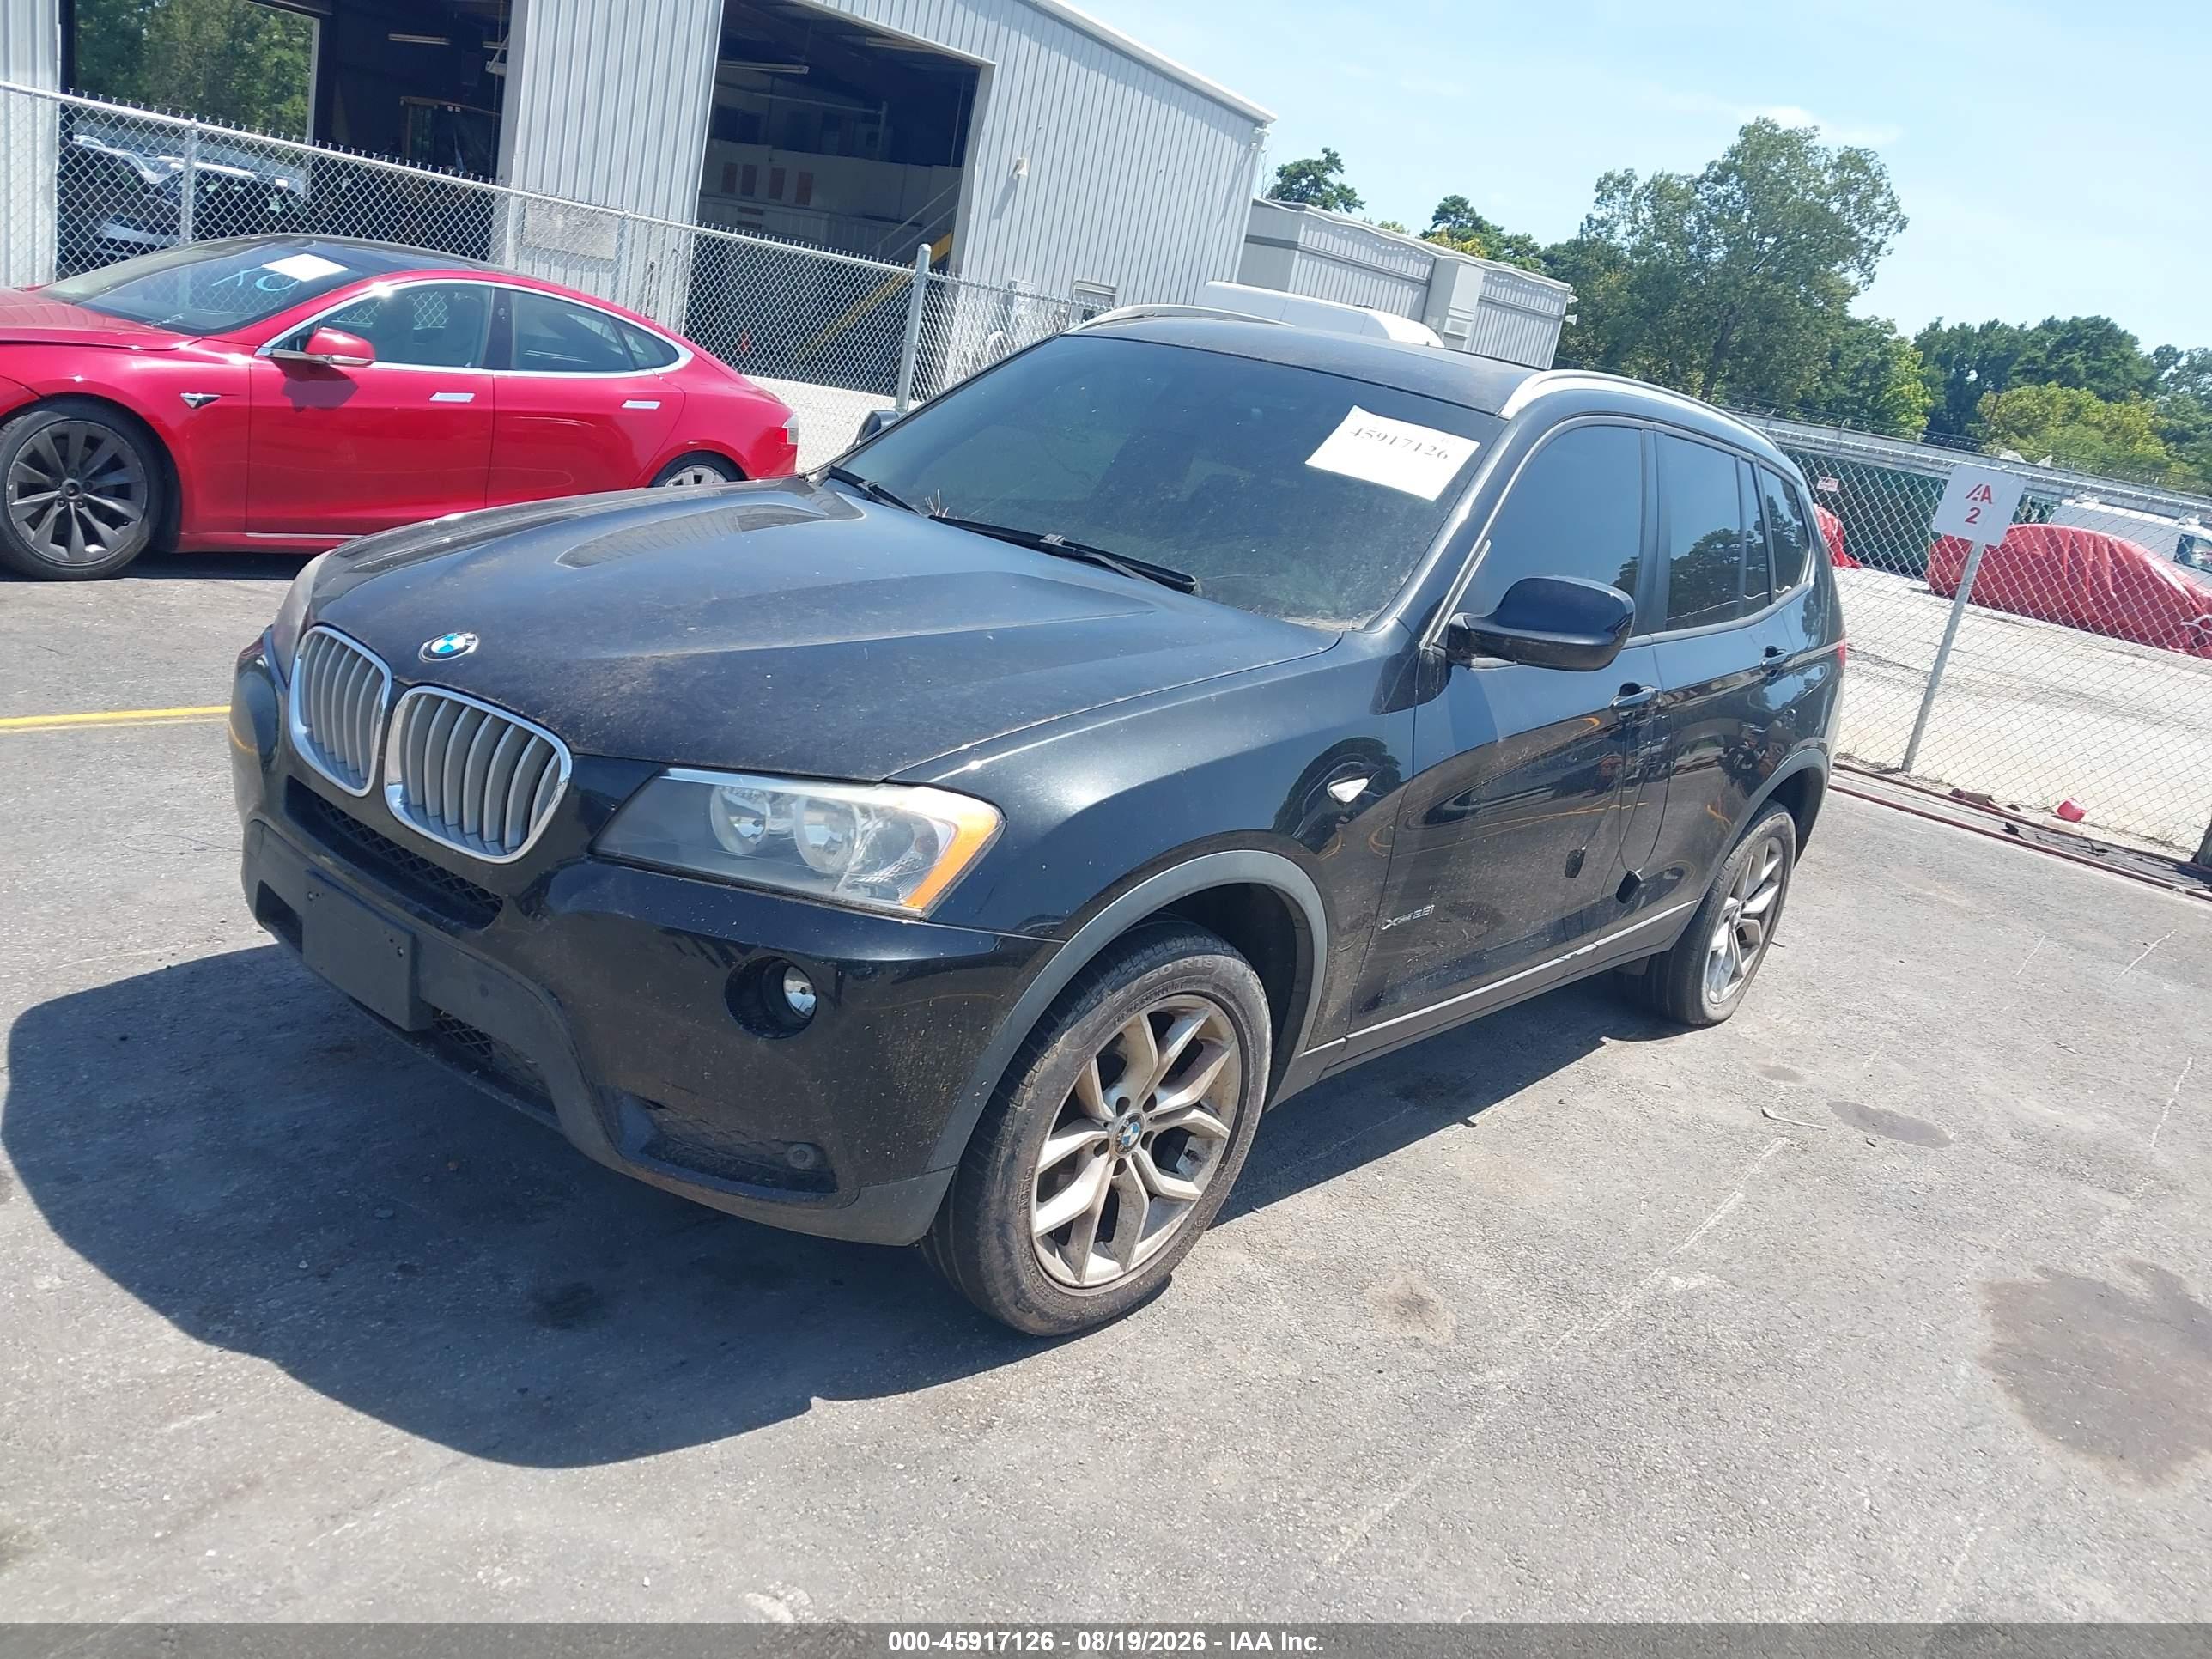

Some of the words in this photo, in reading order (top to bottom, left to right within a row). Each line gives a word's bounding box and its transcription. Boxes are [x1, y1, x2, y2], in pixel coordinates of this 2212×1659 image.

[1350, 428, 1449, 459] 45917126
[1965, 483, 1992, 504] IAA
[1964, 507, 1981, 525] 2
